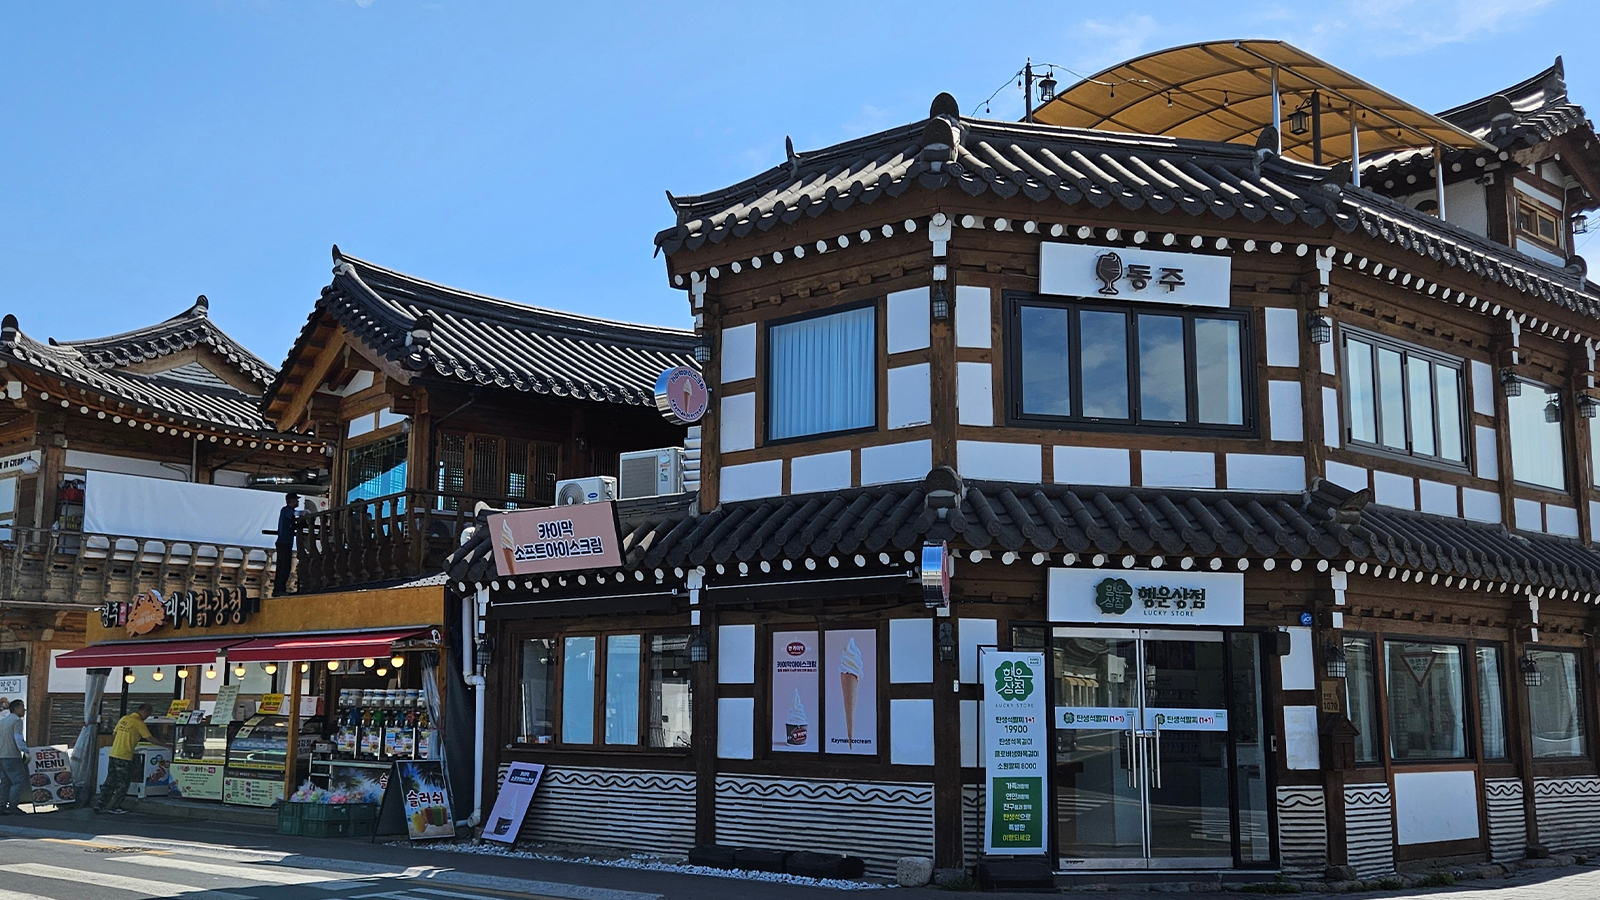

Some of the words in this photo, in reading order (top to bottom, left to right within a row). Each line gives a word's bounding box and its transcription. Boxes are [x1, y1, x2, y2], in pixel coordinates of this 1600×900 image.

[1127, 264, 1186, 292] 동주
[538, 520, 574, 539] 카이막
[515, 537, 603, 561] 소프트아이스크림
[1138, 586, 1205, 609] 행운상점
[1323, 702, 1338, 710] 1070
[1109, 715, 1125, 723] (1+1)
[1199, 716, 1214, 724] (1+1)
[1004, 725, 1028, 733] 19900
[35, 751, 61, 761] BEST
[35, 759, 65, 769] MENU
[407, 790, 445, 808] 슬러쉬
